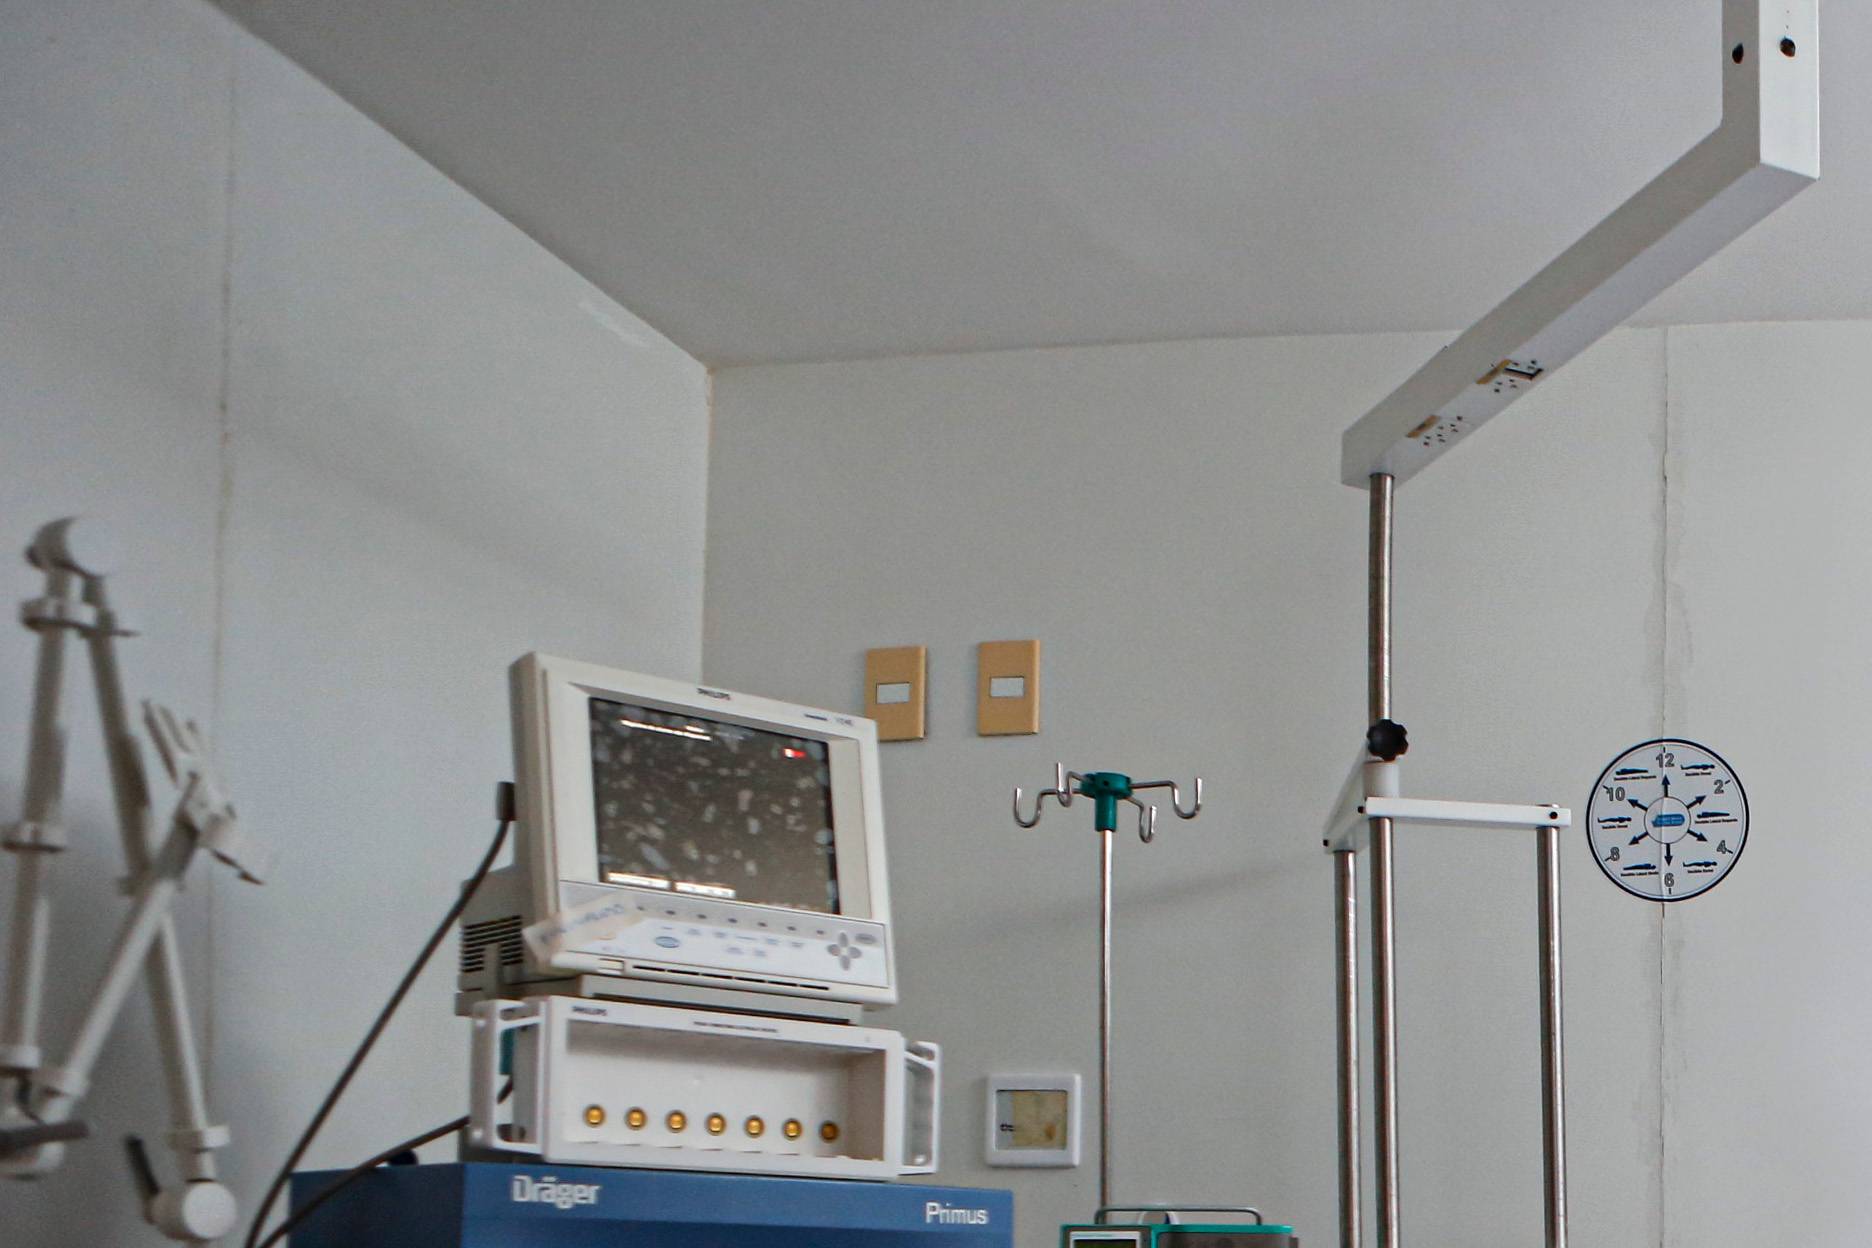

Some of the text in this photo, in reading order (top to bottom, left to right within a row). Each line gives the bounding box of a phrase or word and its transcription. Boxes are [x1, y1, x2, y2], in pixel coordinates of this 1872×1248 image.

[1655, 753, 1675, 768] 12
[1714, 779, 1724, 794] 2
[1607, 787, 1625, 801] 10
[1610, 847, 1620, 861] 8
[1716, 840, 1727, 854] 4
[1664, 873, 1674, 887] 6
[512, 1174, 603, 1210] Dräger
[926, 1201, 990, 1225] Primus
